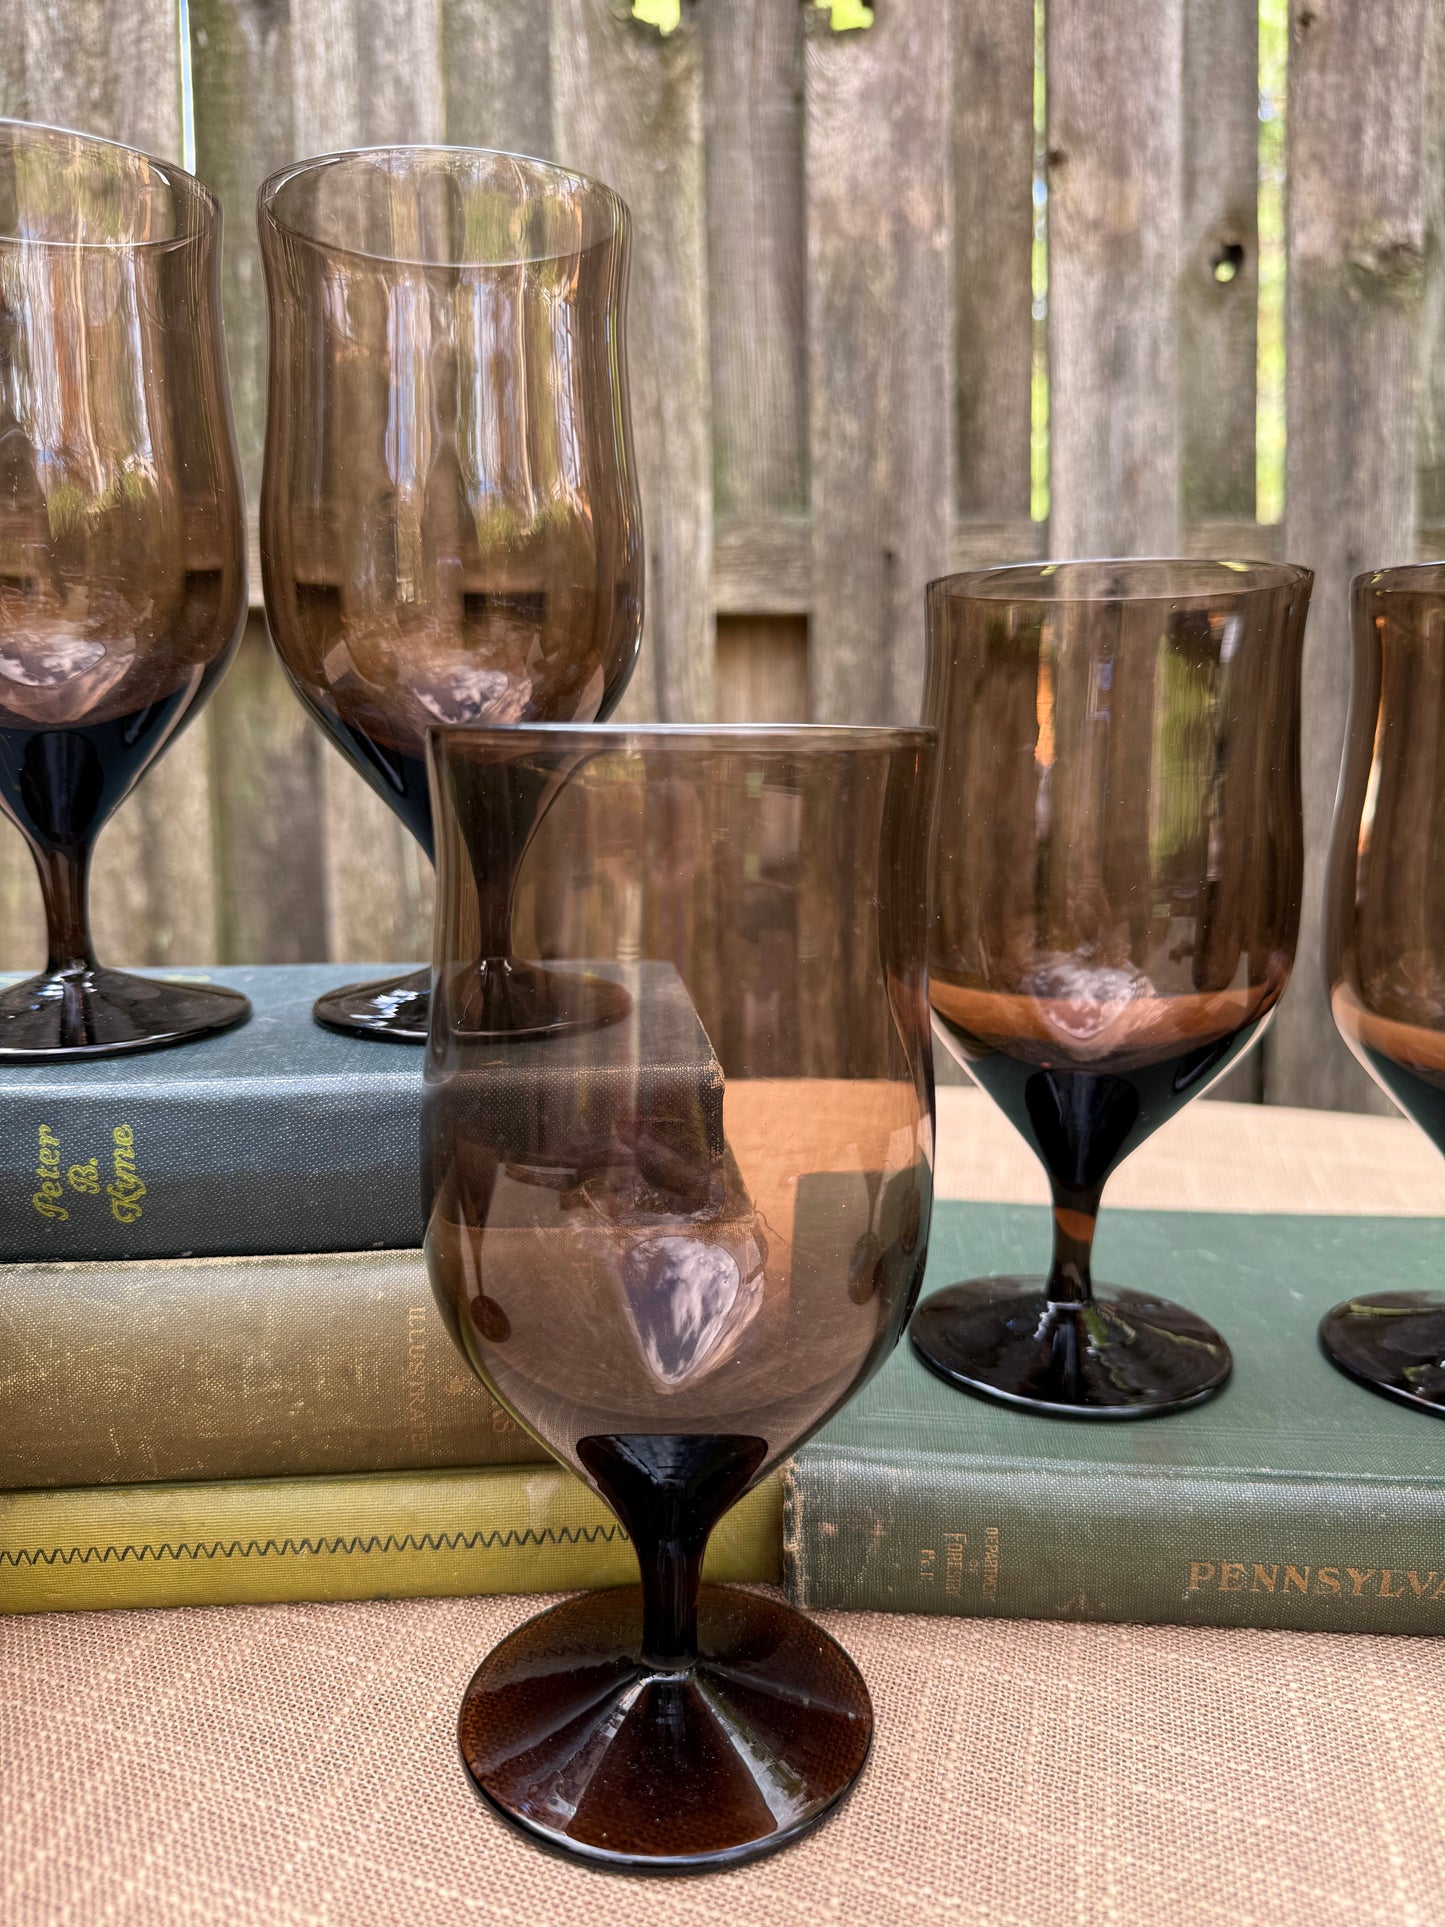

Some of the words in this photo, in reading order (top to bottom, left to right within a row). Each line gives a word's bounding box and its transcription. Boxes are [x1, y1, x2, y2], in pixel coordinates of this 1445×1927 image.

[33, 1123, 70, 1221] Peter
[67, 1157, 100, 1195] B.
[106, 1123, 147, 1223] Kyne
[982, 1526, 1000, 1602] DEPARTMEN
